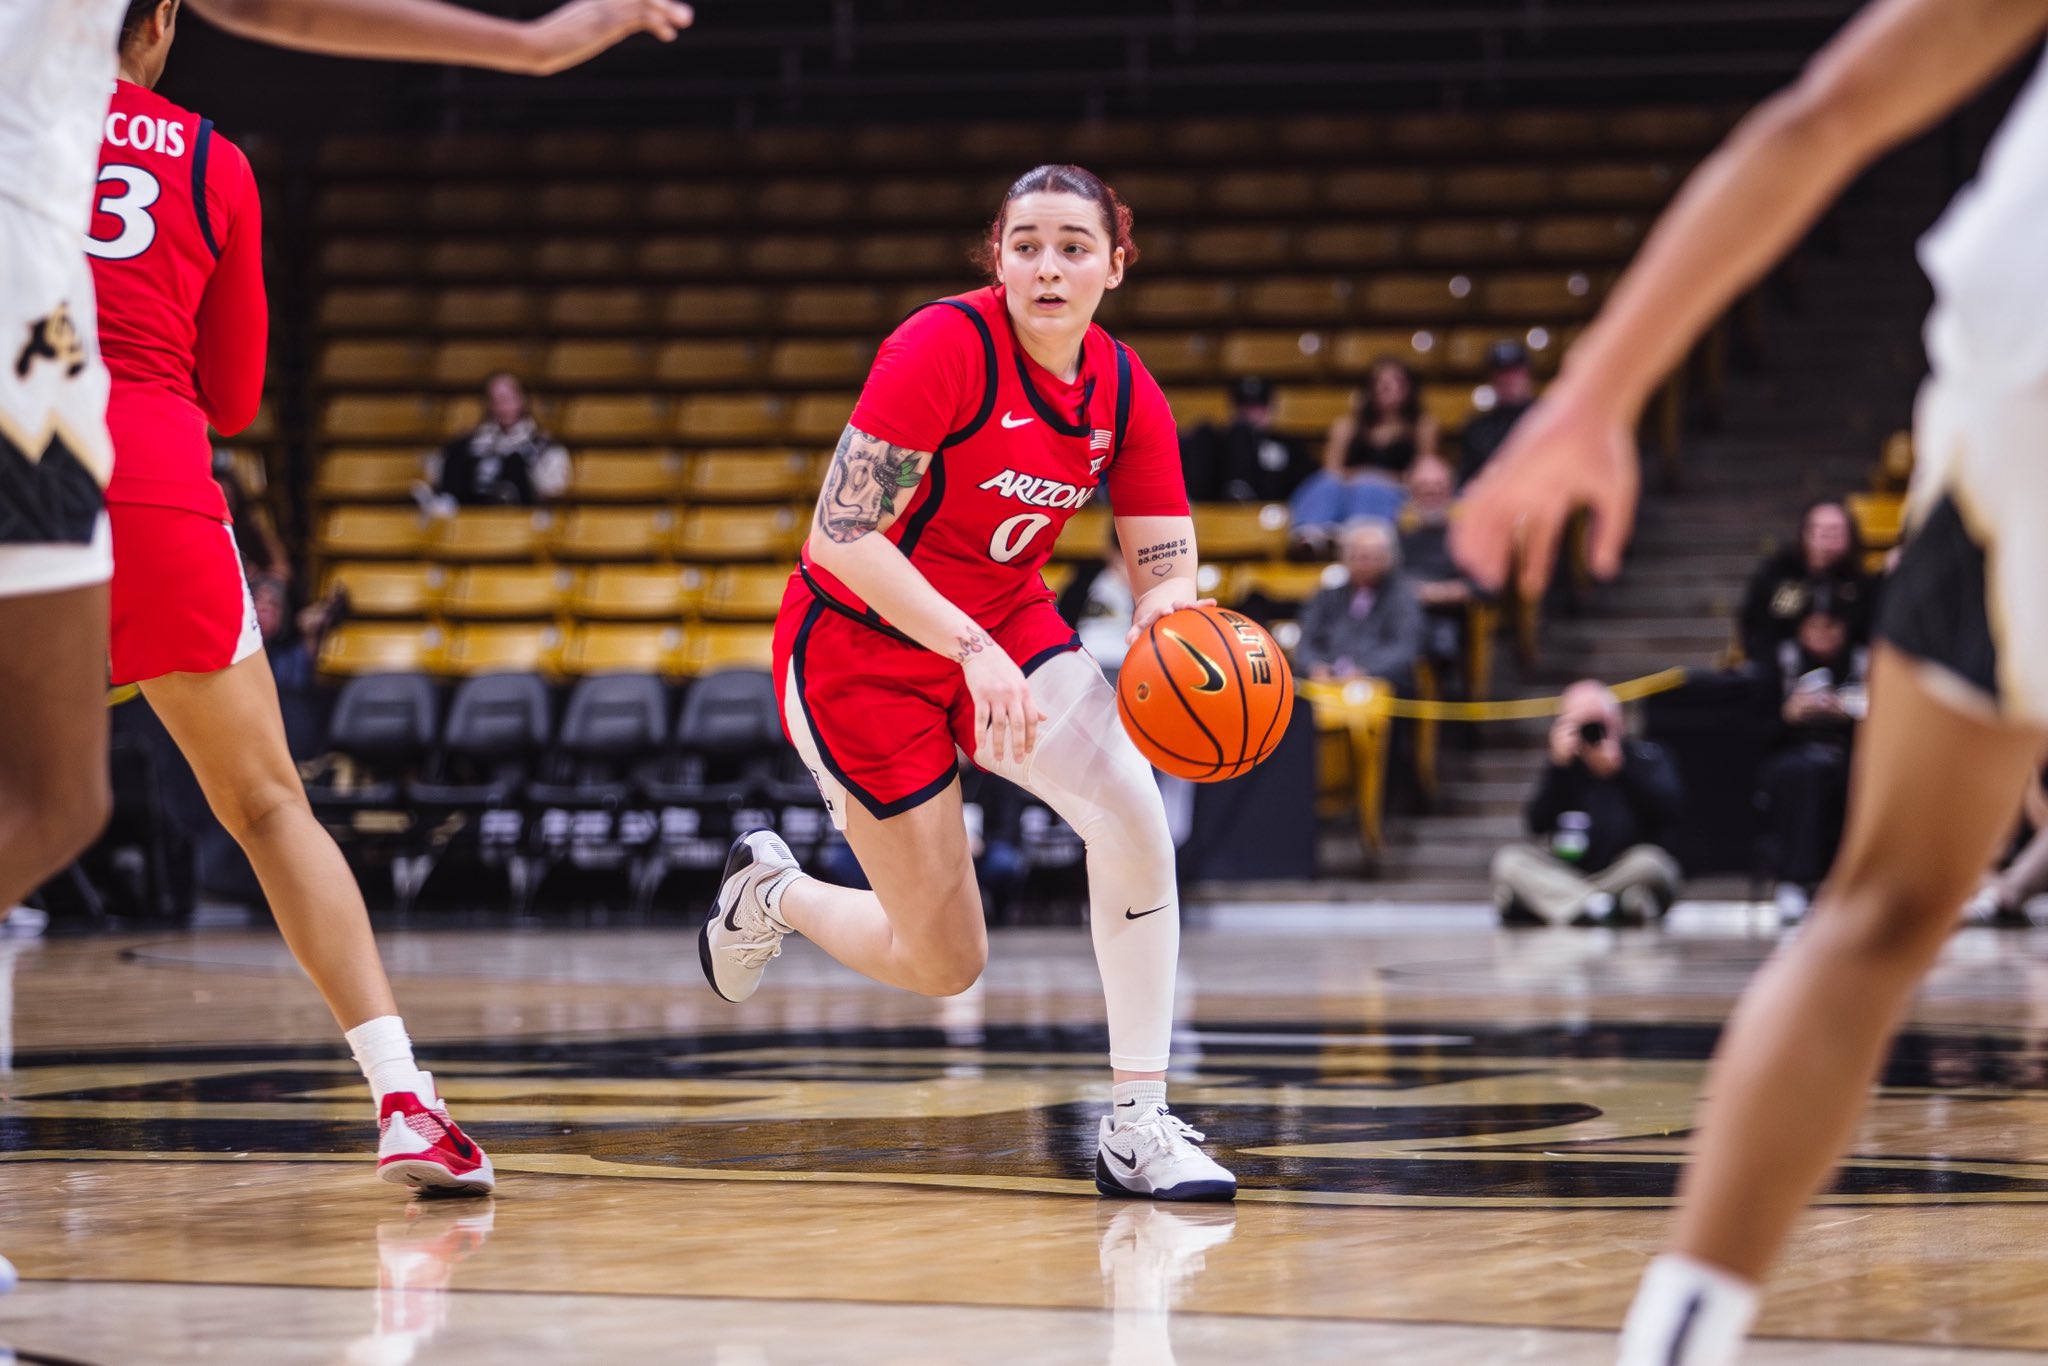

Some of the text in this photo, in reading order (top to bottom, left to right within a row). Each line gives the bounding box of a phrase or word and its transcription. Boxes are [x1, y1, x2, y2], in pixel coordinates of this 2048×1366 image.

[98, 111, 185, 158] COIS
[86, 164, 161, 260] 3
[978, 467, 1095, 509] ARIZON
[989, 513, 1052, 563] 0
[1218, 612, 1272, 684] ELITE
